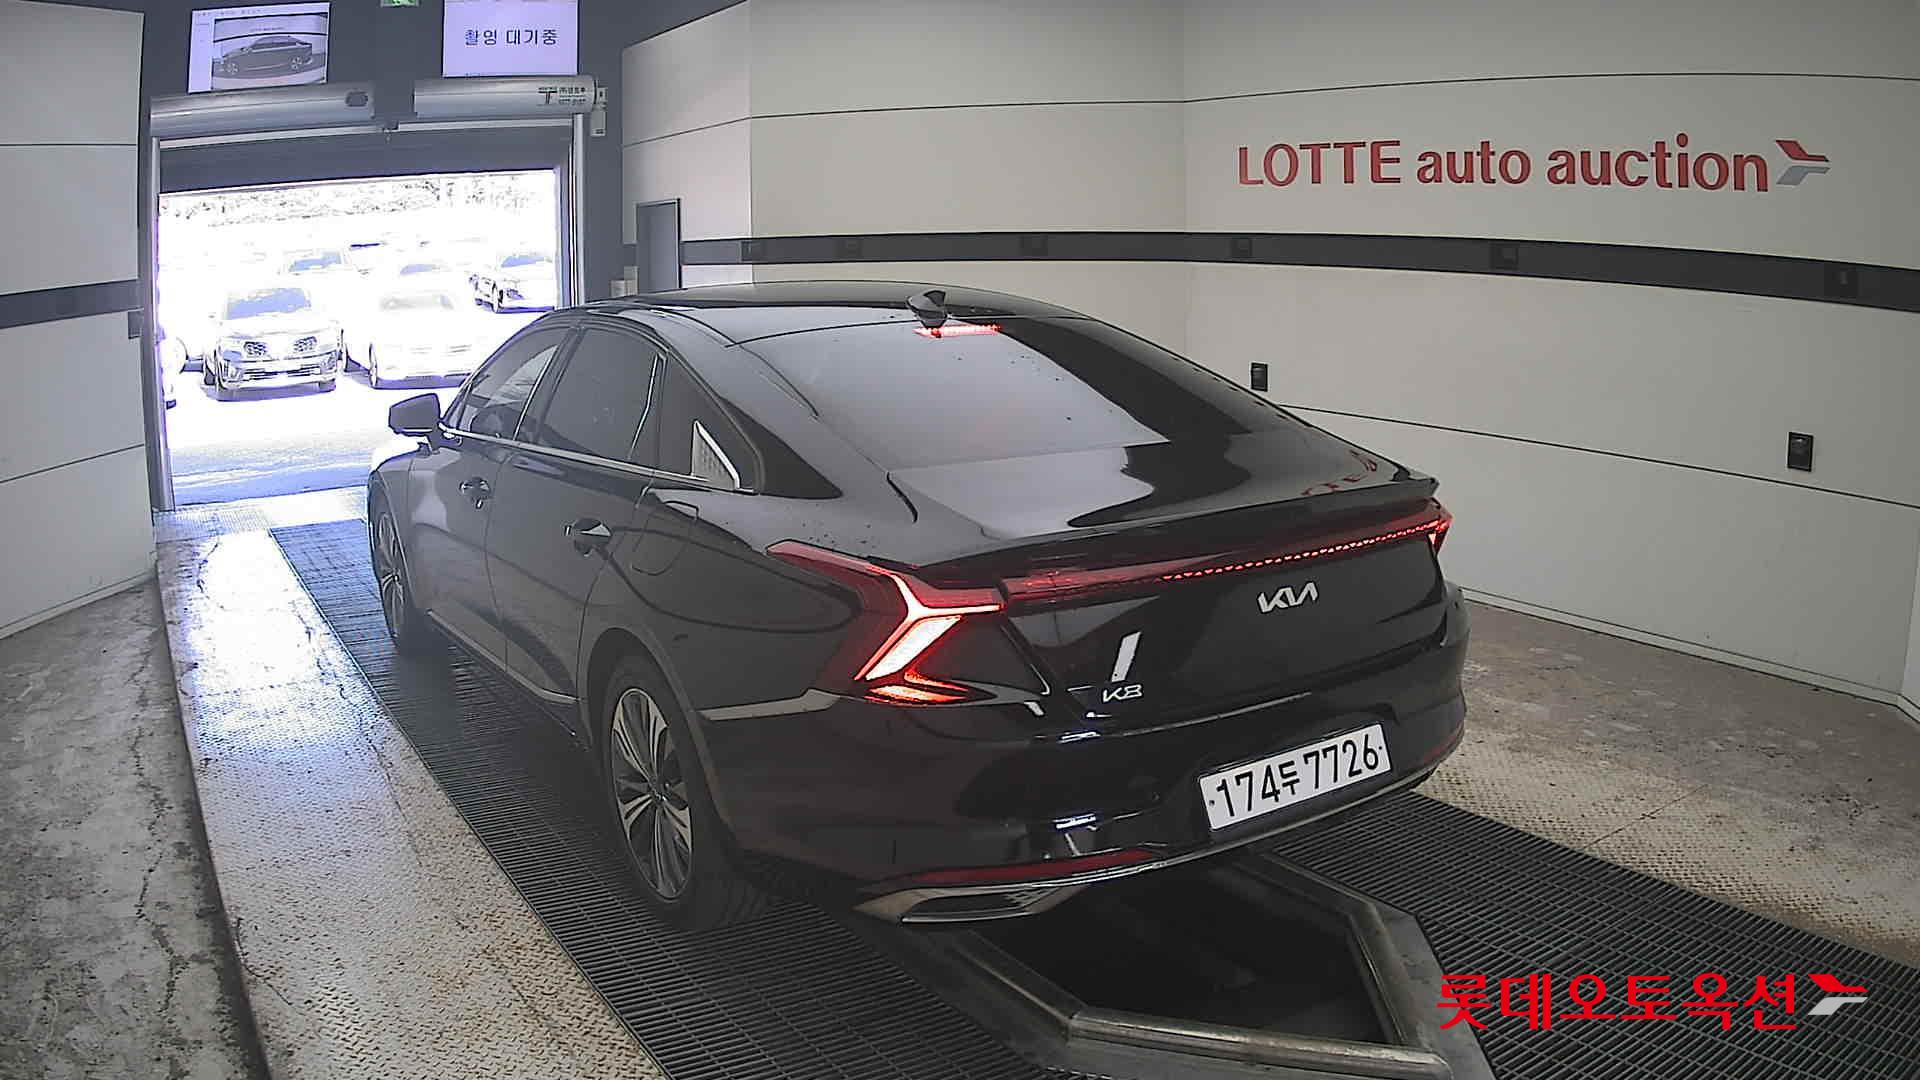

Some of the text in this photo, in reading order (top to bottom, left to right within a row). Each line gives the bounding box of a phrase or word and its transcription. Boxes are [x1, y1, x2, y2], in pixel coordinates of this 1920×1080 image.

[506, 29, 557, 46] 대기중
[1239, 132, 1769, 192] LOTTE auto auction
[1257, 581, 1318, 612] KIA
[1102, 684, 1143, 702] K8
